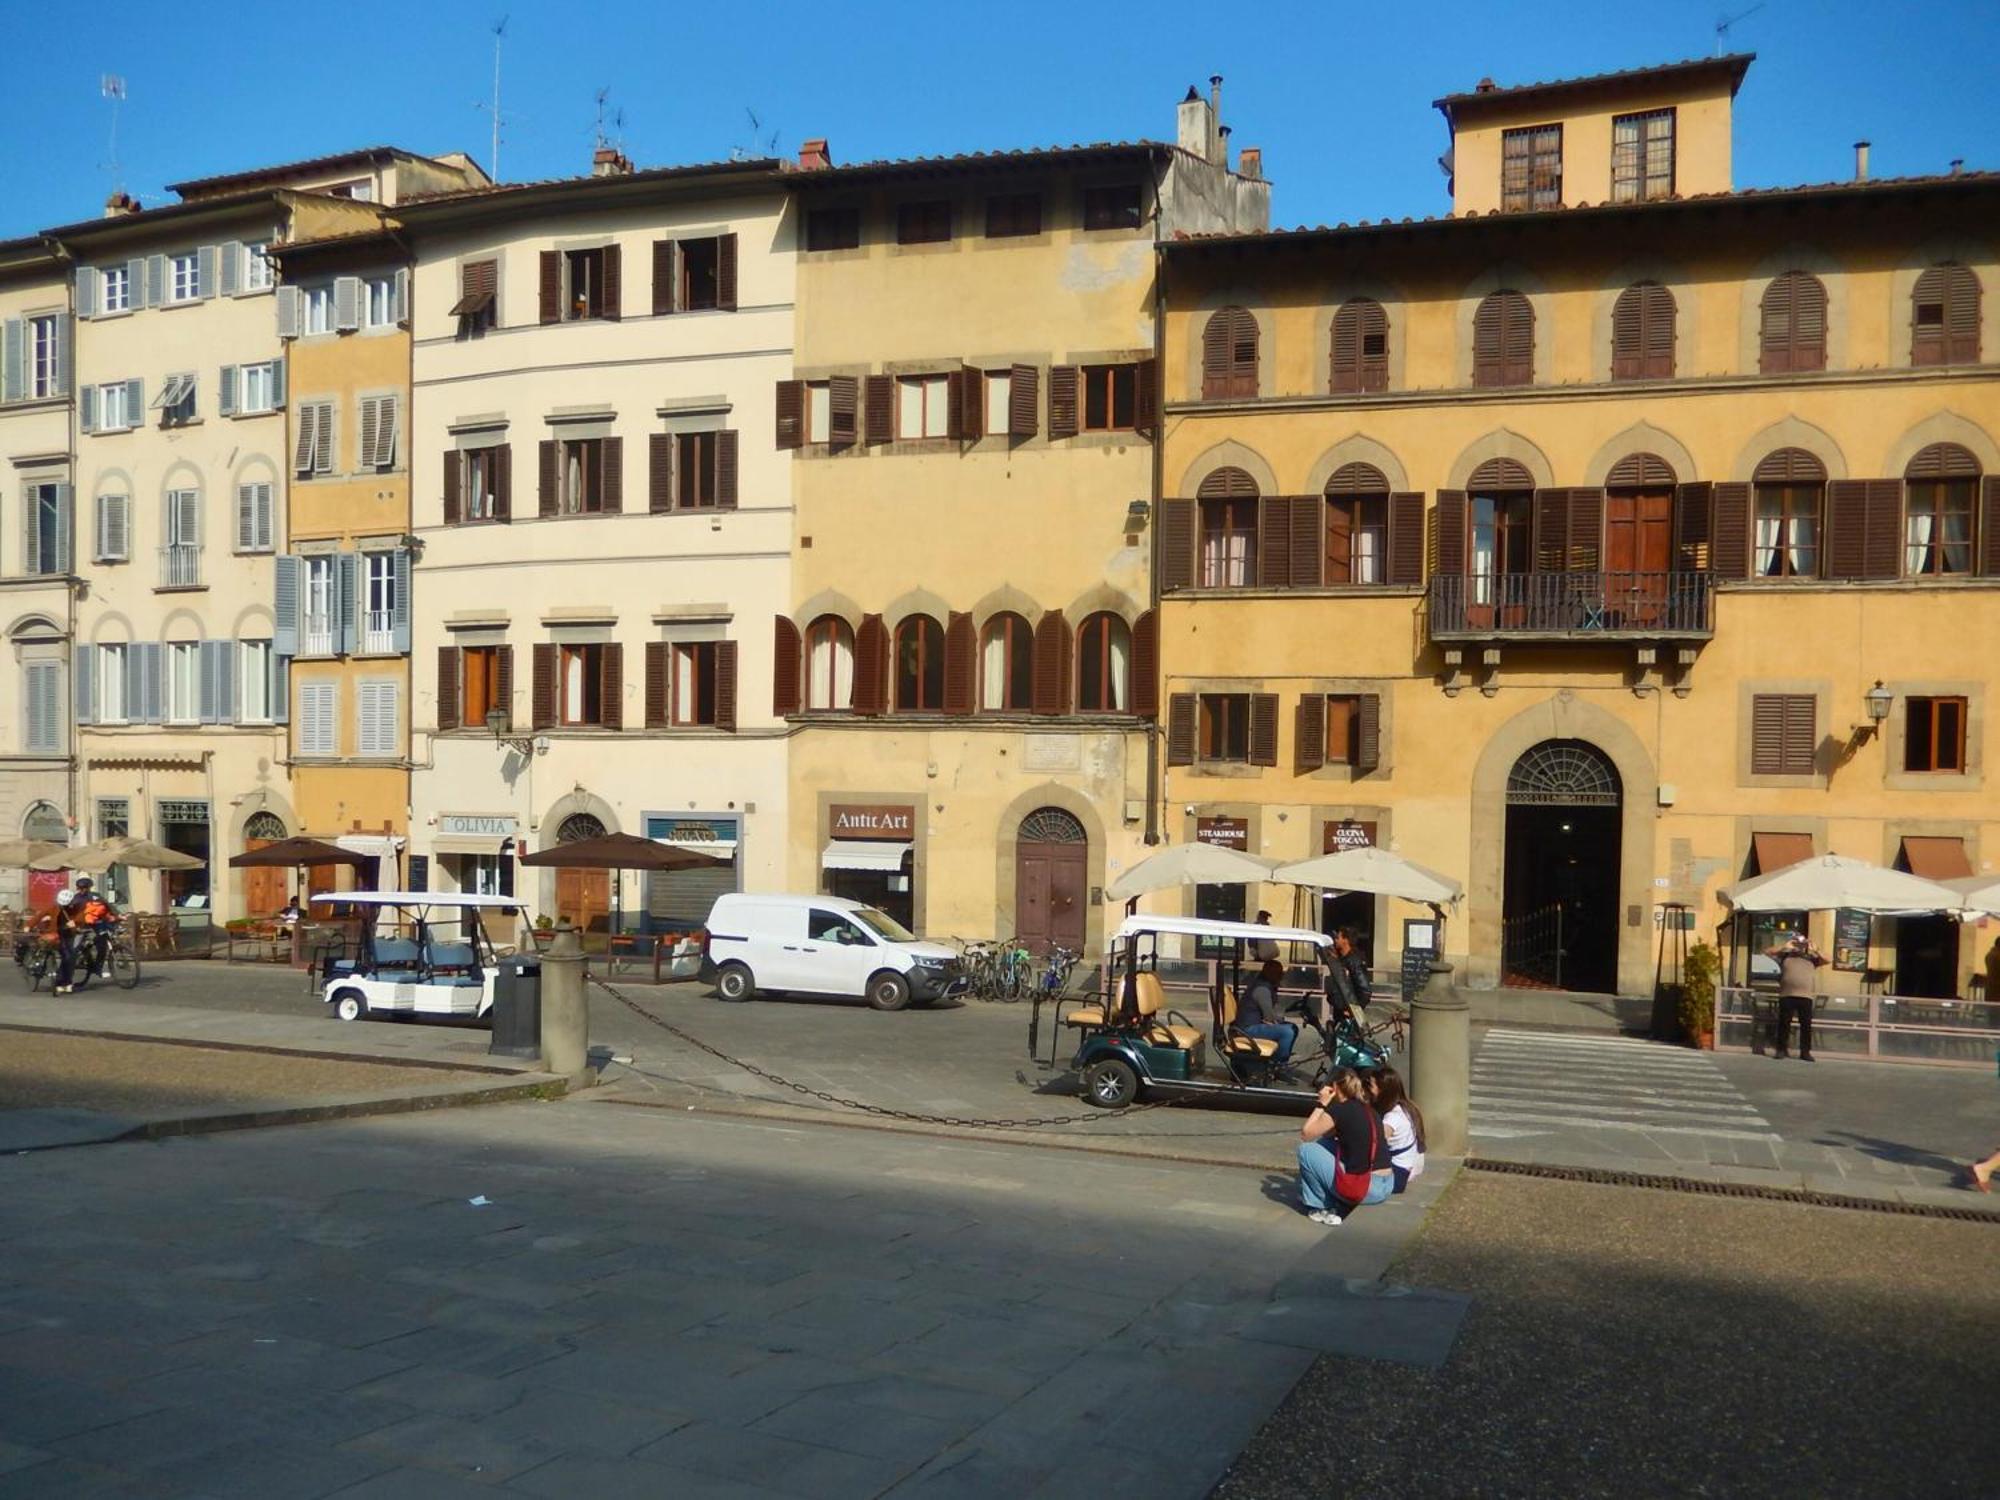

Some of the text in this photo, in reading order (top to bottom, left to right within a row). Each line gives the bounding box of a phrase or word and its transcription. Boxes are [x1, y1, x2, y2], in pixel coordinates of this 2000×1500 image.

[836, 812, 908, 829] Antic Art
[1198, 830, 1246, 838] STEAKHOUSE
[1336, 829, 1365, 837] CUCINA
[1332, 836, 1370, 845] TOSCANA
